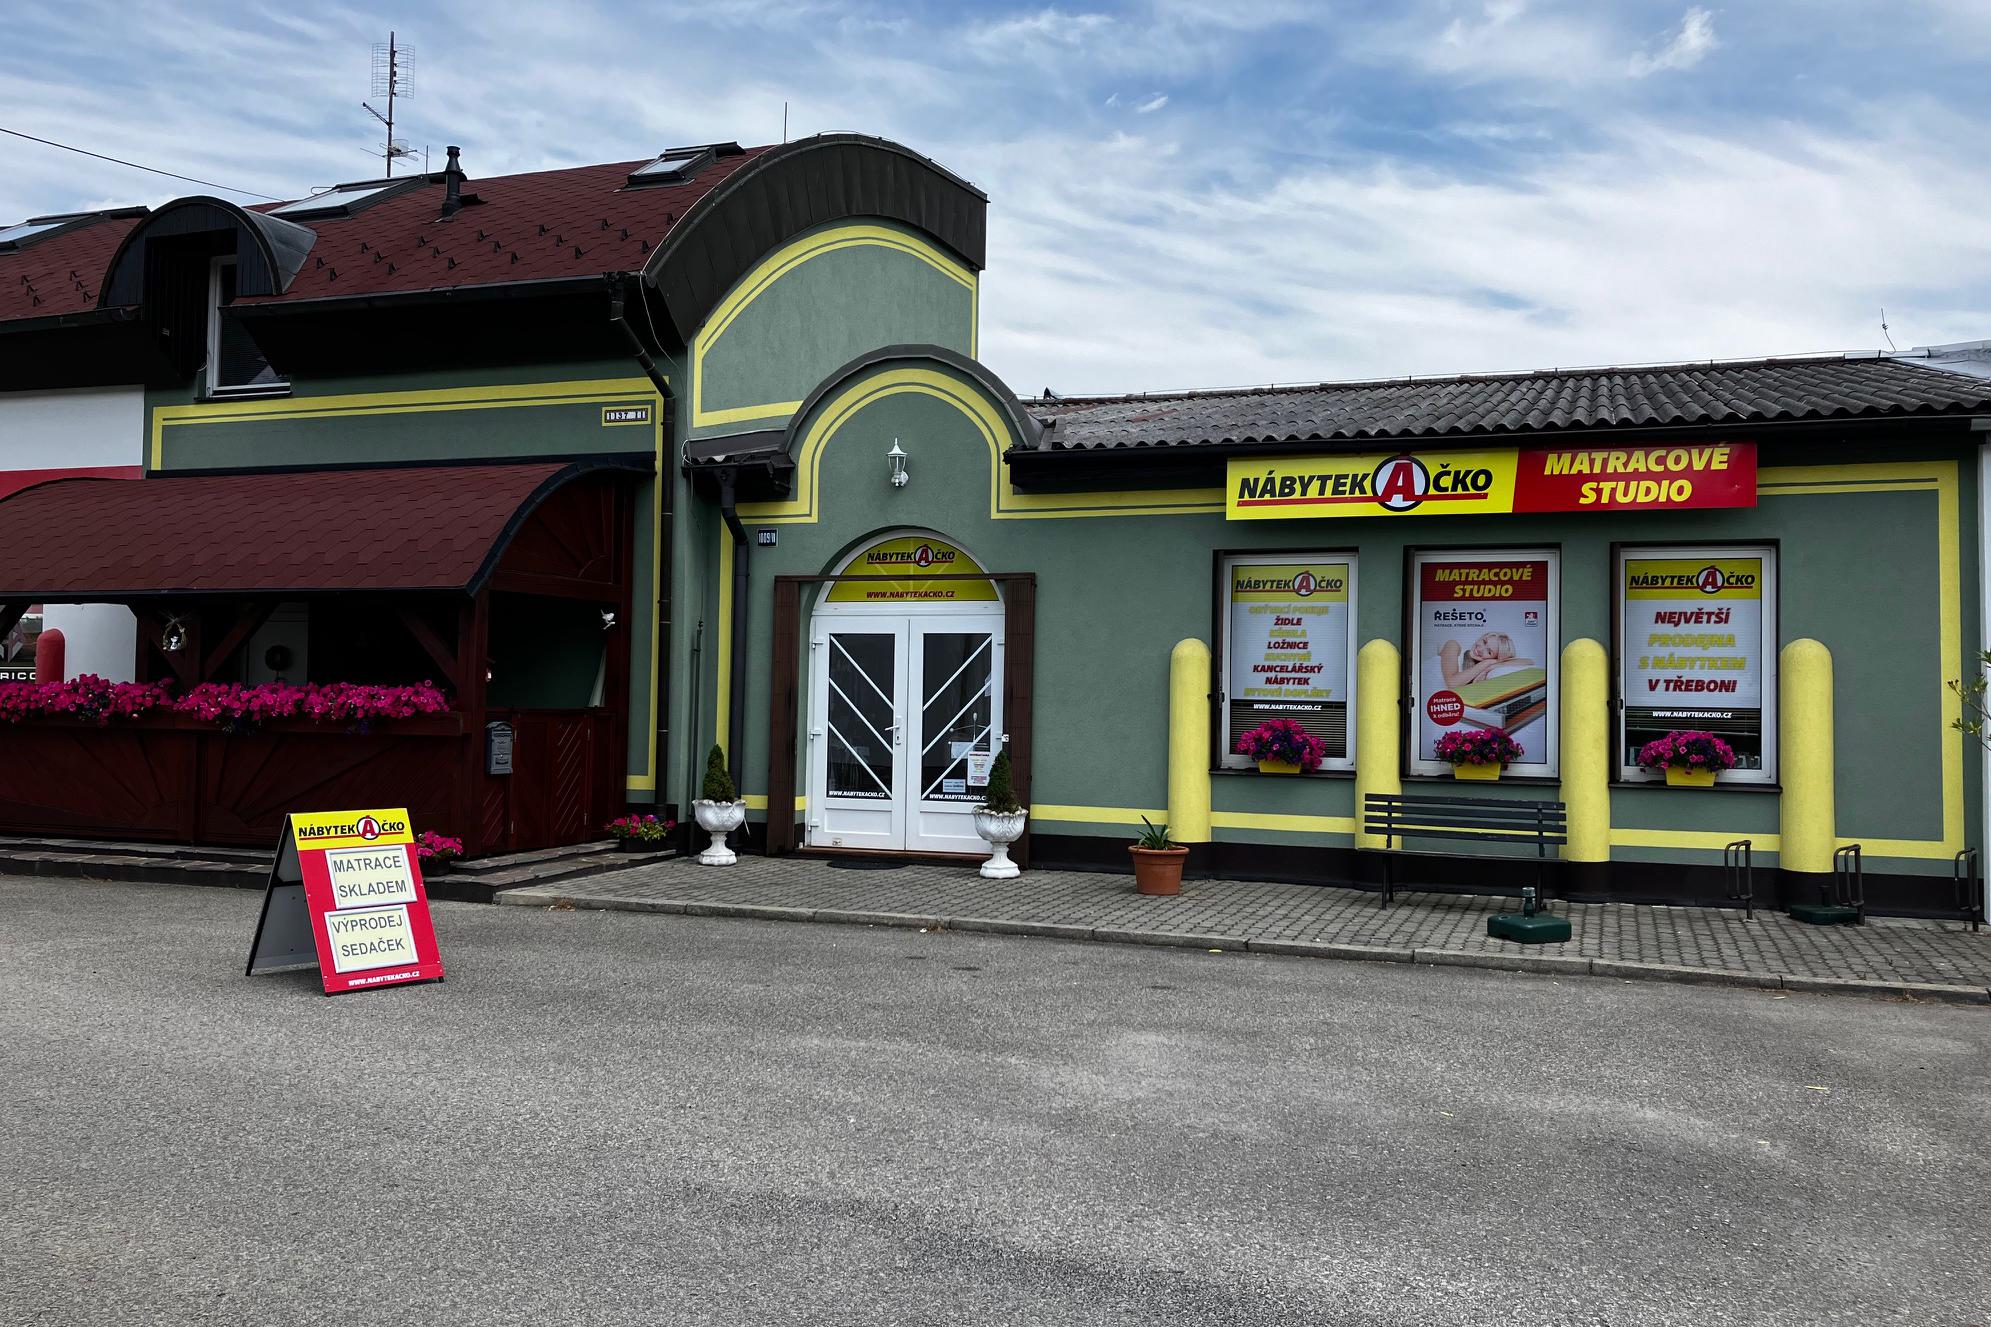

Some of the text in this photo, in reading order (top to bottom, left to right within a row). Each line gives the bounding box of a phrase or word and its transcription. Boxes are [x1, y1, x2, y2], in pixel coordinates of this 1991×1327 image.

[1544, 442, 1731, 476] MATRACOVÉ
[1237, 470, 1371, 499] NÁBYTEK
[1579, 479, 1693, 505] STUDIO
[867, 550, 914, 561] NÁBYTEK
[1435, 564, 1533, 581] MATRACOVÉ
[1629, 572, 1697, 586] NÁBYTEK
[1235, 577, 1293, 590] NÁBYTEK
[866, 590, 956, 599] WWW.NABYTEKACKO.CZ
[1453, 584, 1514, 598] STUDIO
[1274, 615, 1303, 626] ŽIDLE
[1654, 607, 1731, 627] NEJVĚTŠÍ
[1267, 639, 1309, 650] LOŽNICE
[1648, 633, 1737, 650] PRODEJNA
[1639, 652, 1747, 670] S NÁBYTKEM
[1253, 663, 1324, 674] KANCELÁŘSKÝ
[1265, 675, 1311, 686] NÁBYTEK
[1647, 675, 1738, 692] V TŘEBONI
[1253, 703, 1323, 711] WWW.NABYTEKACKO.CZ
[1430, 703, 1461, 713] IHNED
[1652, 710, 1733, 719] WWW.NABYTEKACKO.CZ
[929, 793, 987, 801] WWW.NABYTEKACKO.C
[298, 823, 357, 837] NÁBYTEK
[333, 855, 402, 873] MATRACE
[339, 879, 407, 898] SKLADEM
[332, 914, 403, 934] VÝPRODEJ
[341, 937, 406, 957] SEDAČEK
[348, 970, 420, 987] WWW.NABYTEKACKO.CZ
